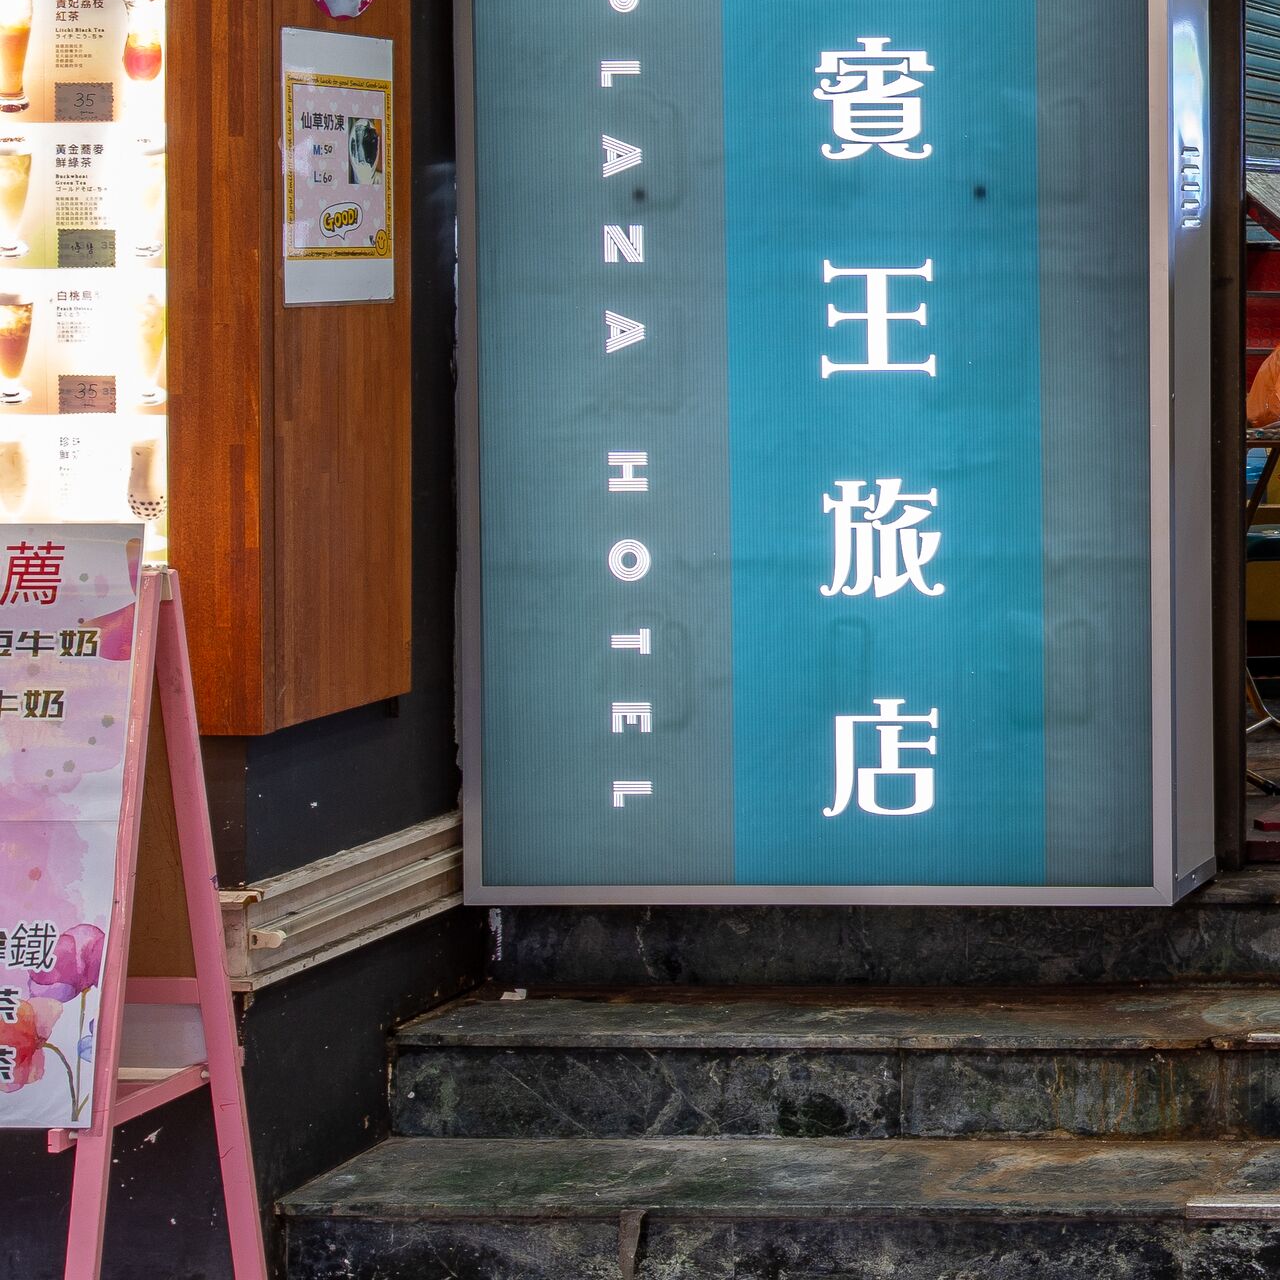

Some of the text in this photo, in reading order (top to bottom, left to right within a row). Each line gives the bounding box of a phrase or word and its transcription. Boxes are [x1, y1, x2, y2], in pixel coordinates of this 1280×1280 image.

[55, 11, 80, 22] 紅茶
[73, 92, 97, 108] 35
[322, 207, 359, 232] GOOD!
[74, 382, 98, 400] 35
[0, 540, 66, 606] 薦
[607, 451, 653, 808] HOTEL
[0, 922, 57, 970] 鐵
